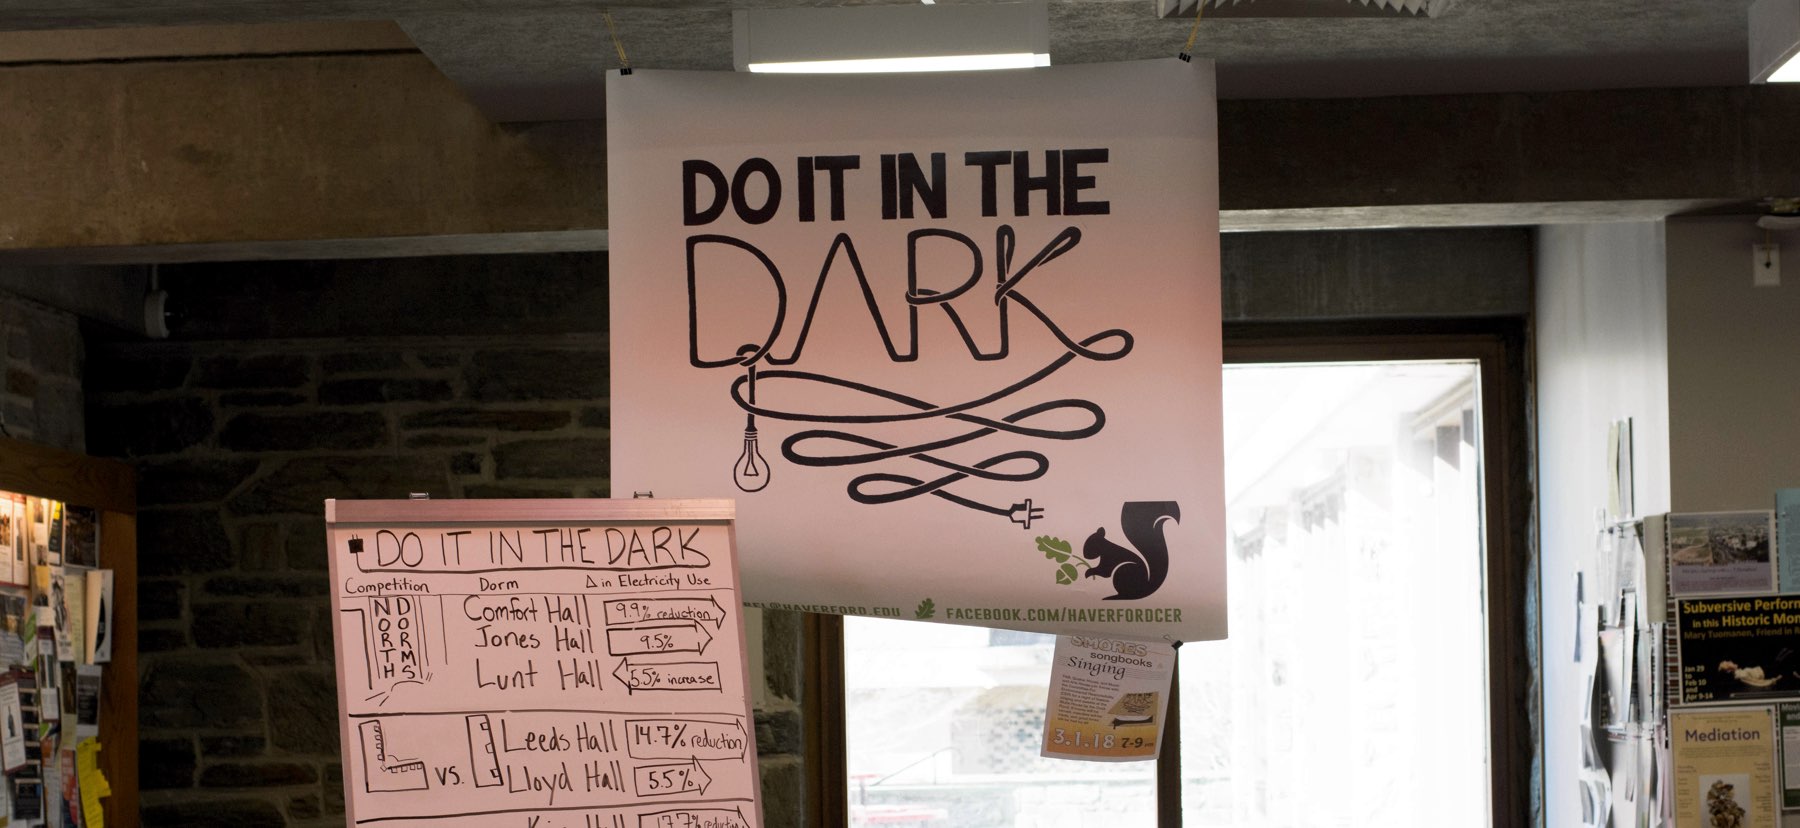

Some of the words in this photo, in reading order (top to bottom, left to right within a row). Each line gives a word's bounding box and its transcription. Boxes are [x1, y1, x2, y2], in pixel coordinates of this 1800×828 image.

[682, 157, 782, 226] DO
[797, 154, 860, 222] IT
[880, 152, 947, 220] IN
[964, 148, 1110, 217] THE
[685, 224, 1090, 369] DARK
[376, 529, 423, 567] DO
[441, 530, 472, 566] IT
[489, 530, 523, 565] IN
[532, 528, 595, 564] THE
[605, 527, 711, 567] DARK
[345, 577, 430, 596] Competition
[479, 577, 519, 591] Dorm
[601, 578, 612, 588] in
[618, 572, 680, 590] Electricity
[687, 574, 711, 586] Use
[463, 594, 538, 622] Comfort
[544, 594, 591, 628] Hall
[616, 602, 652, 621] 9.9%
[656, 605, 711, 621] reduction
[946, 607, 1182, 623] FACEBOOK.COM/HAVERFORDCER
[1683, 600, 1751, 614] Subversive
[1692, 620, 1701, 628] in
[1702, 619, 1719, 628] this
[1722, 614, 1770, 627] Historic
[373, 597, 397, 679] NORTH
[396, 597, 417, 680] DORMS
[474, 624, 541, 649] Jones
[554, 625, 594, 654] Hall
[640, 632, 674, 650] 9.5%
[1071, 634, 1148, 657] SMORES
[1683, 631, 1706, 640] Mary
[1067, 656, 1126, 680] Singing
[1090, 652, 1153, 668] songbooks
[476, 658, 539, 690] Lunt
[558, 658, 603, 691] Hall
[630, 667, 661, 688] 5.5%
[667, 673, 715, 685] increase
[501, 719, 571, 752] Leeds
[576, 719, 618, 753] Hall
[635, 722, 687, 748] 14.7%
[691, 727, 743, 751] reduction
[1053, 728, 1115, 749] 3.1.18
[1121, 737, 1143, 749] 7-9
[1685, 728, 1760, 742] Mediation
[507, 761, 573, 806] Lloyd
[585, 760, 626, 792] Hall
[649, 768, 694, 790] 5.5%
